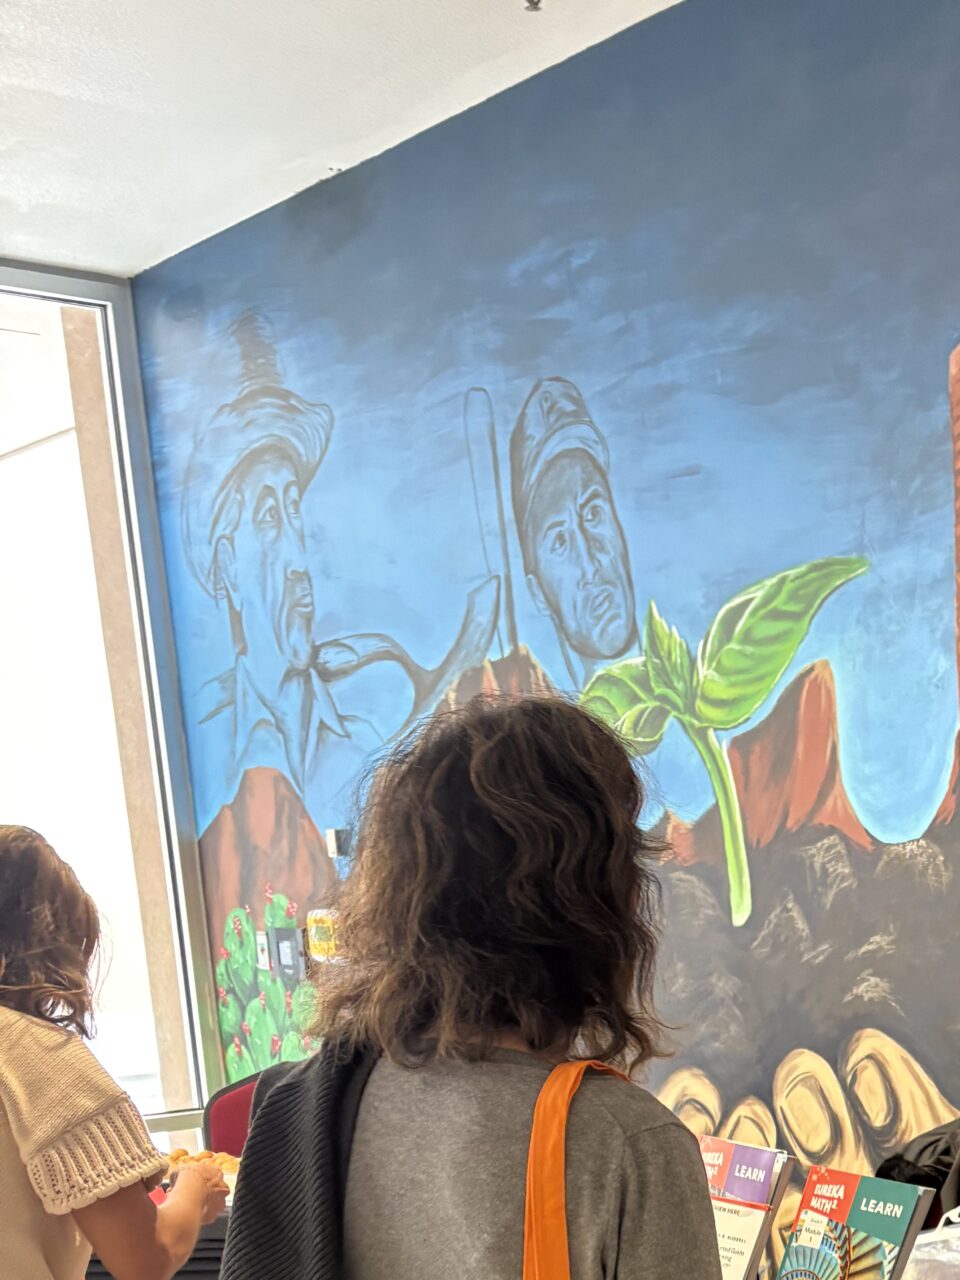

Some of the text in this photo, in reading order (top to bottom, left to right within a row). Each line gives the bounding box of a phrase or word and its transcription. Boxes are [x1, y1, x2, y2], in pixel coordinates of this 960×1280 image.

[734, 1163, 766, 1183] LEARN
[814, 1183, 845, 1200] EUREKA
[860, 1197, 904, 1219] LEARN
